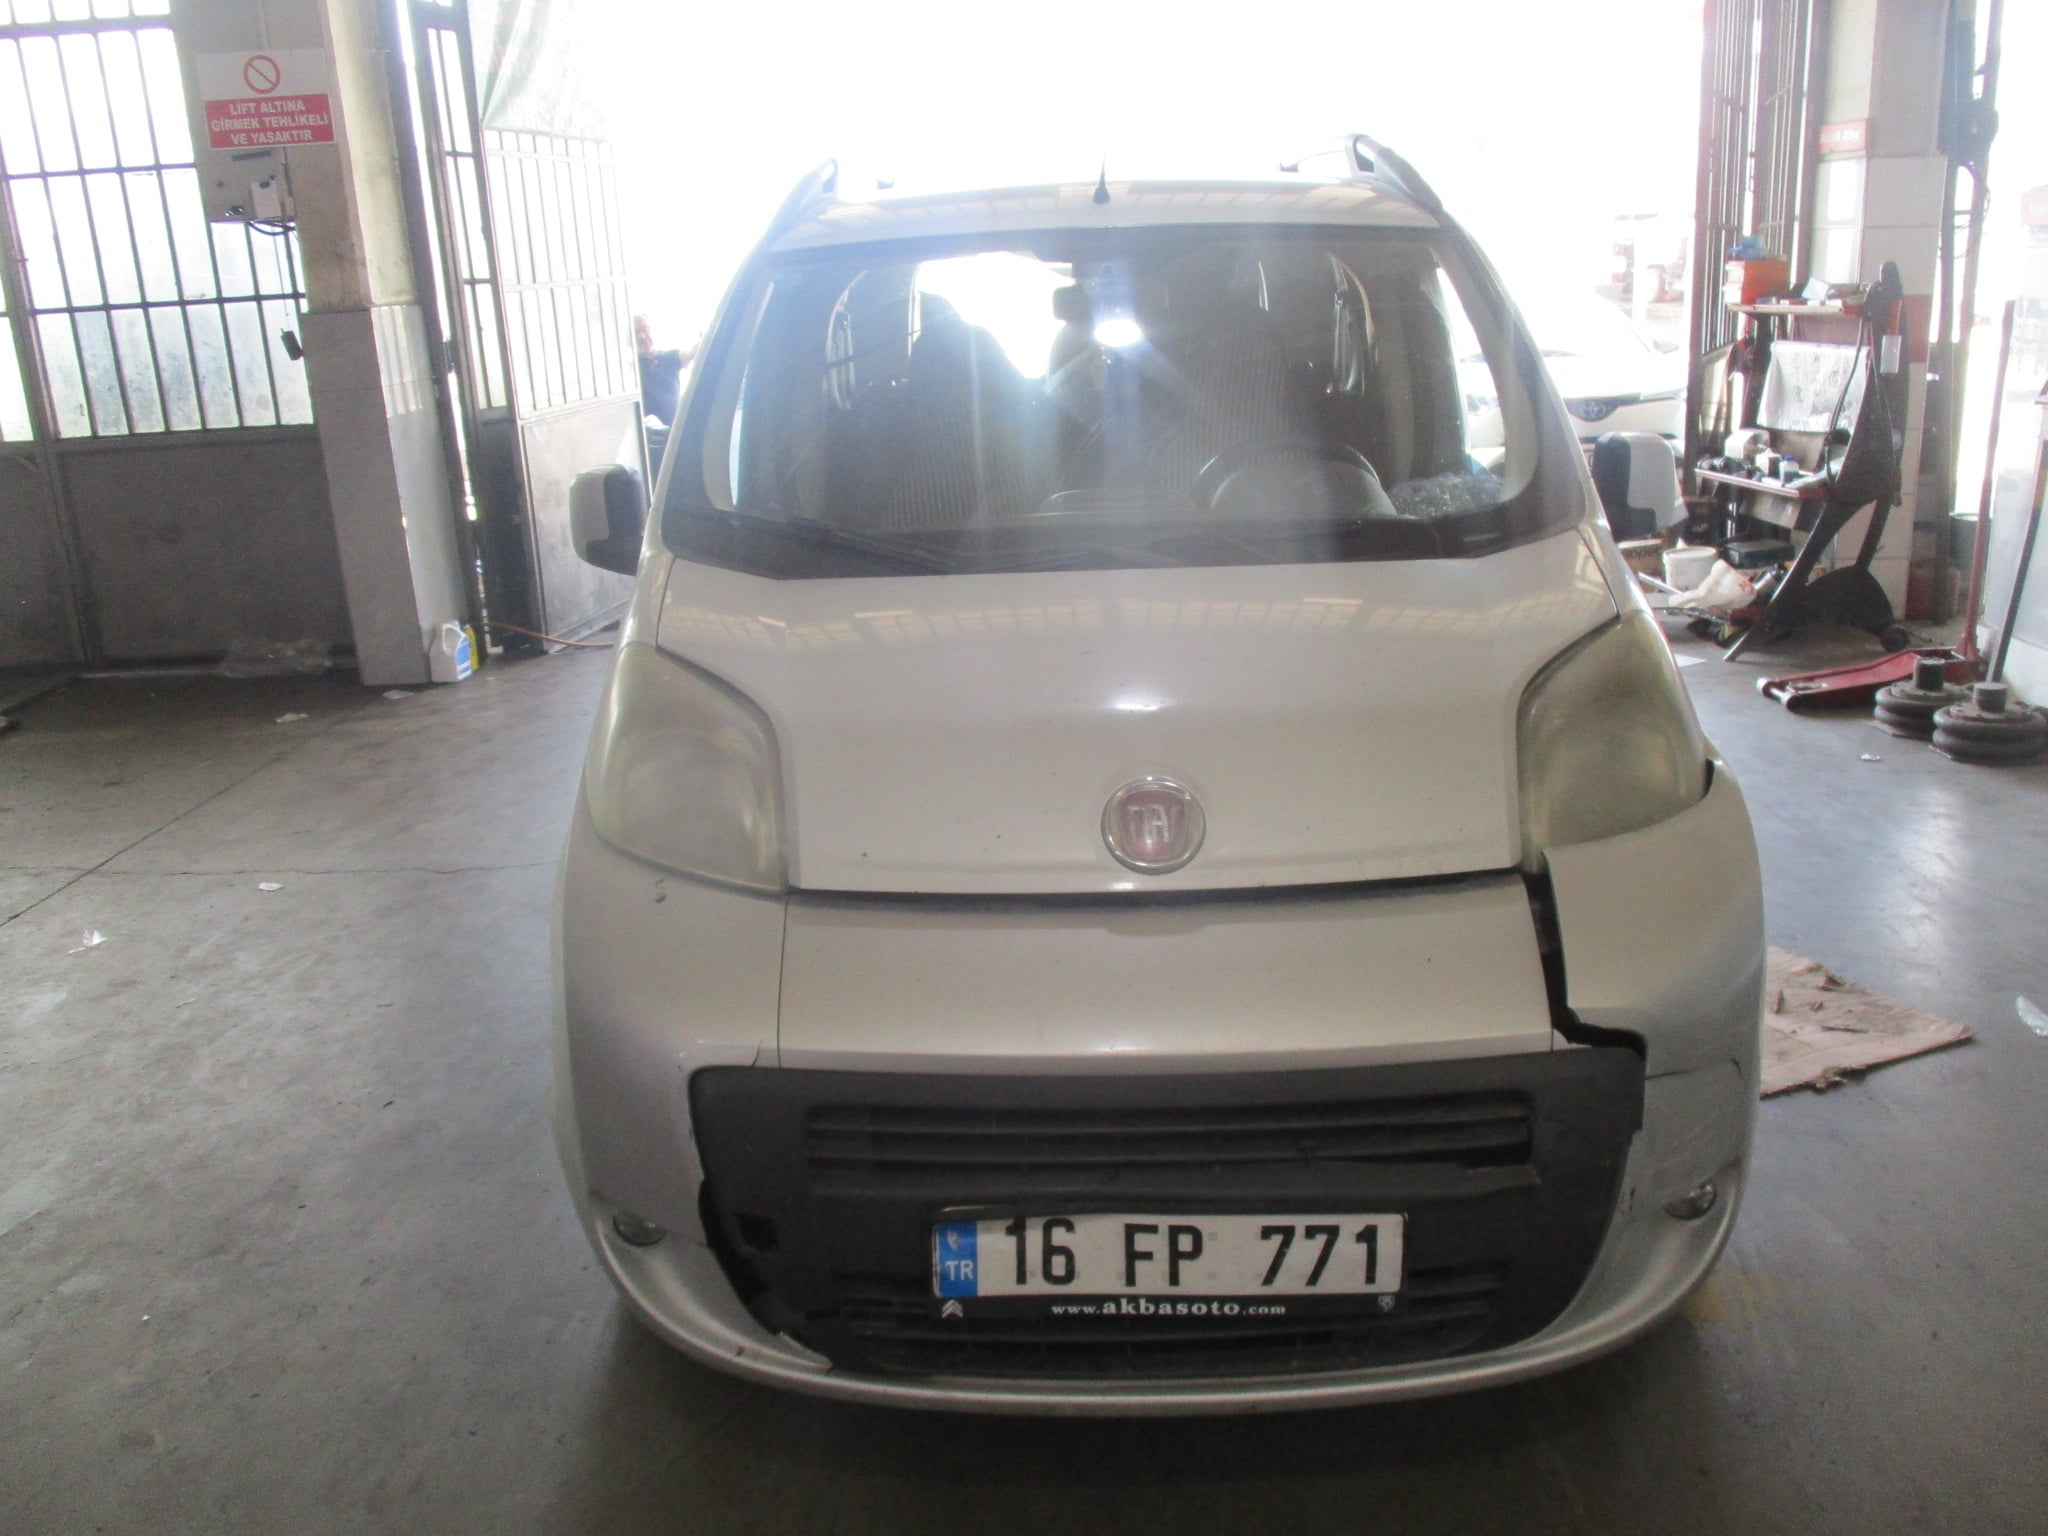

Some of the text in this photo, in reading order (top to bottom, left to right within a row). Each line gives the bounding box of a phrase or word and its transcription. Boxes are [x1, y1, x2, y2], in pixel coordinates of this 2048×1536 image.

[261, 100, 305, 113] ALTINA
[211, 112, 328, 132] GİRMEK TEHLİKELİ
[230, 130, 312, 145] VE YASAKTIR
[1005, 1214, 1379, 1287] 16 FP 771
[944, 1259, 974, 1281] TR
[1051, 1298, 1287, 1316] www.akbasoto.com
